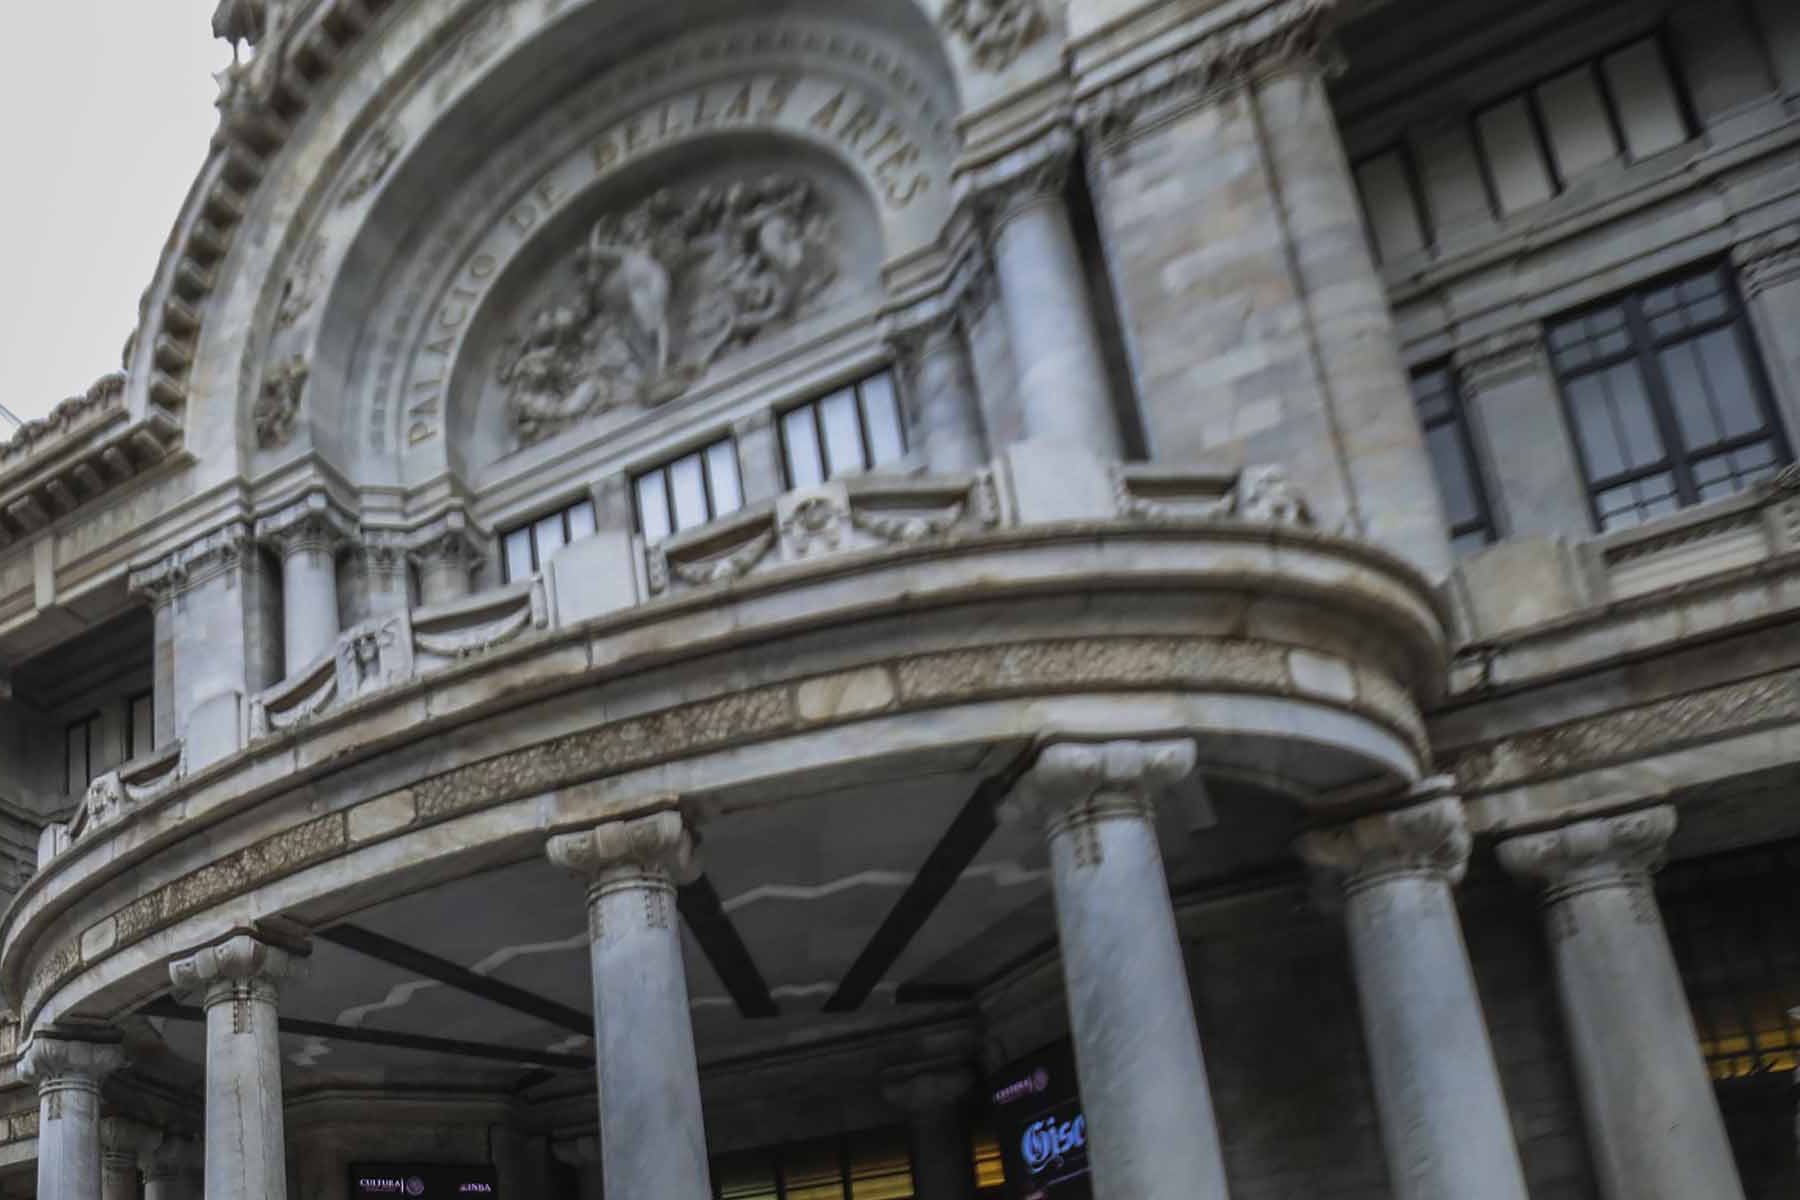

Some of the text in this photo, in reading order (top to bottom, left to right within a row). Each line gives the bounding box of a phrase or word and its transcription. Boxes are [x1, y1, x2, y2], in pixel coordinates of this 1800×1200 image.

[408, 84, 933, 447] PALACIO DE BELLAS ARTES
[1021, 1114, 1085, 1174] Gise
